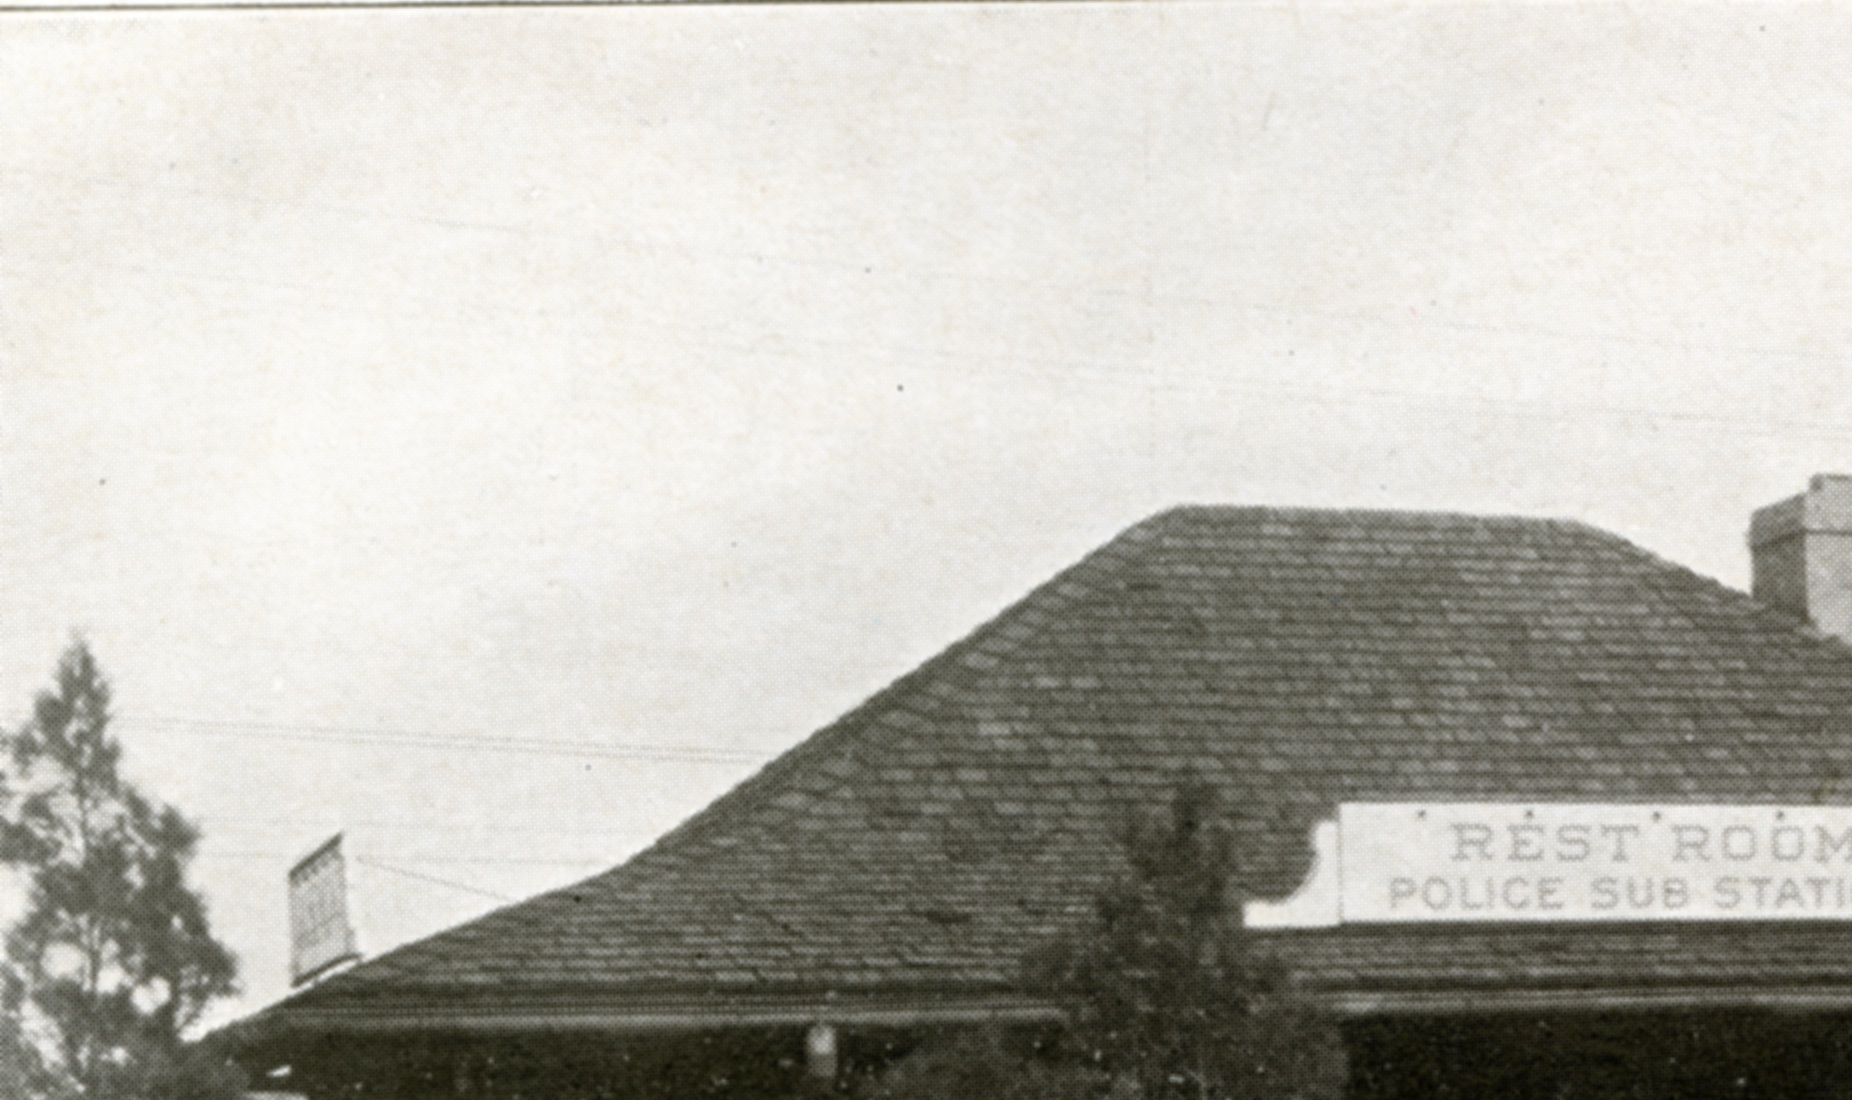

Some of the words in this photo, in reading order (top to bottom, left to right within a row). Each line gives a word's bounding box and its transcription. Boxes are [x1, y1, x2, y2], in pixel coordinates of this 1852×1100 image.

[1452, 823, 1640, 862] REST
[1389, 877, 1565, 909] POLICE
[1590, 877, 1690, 909] SUB
